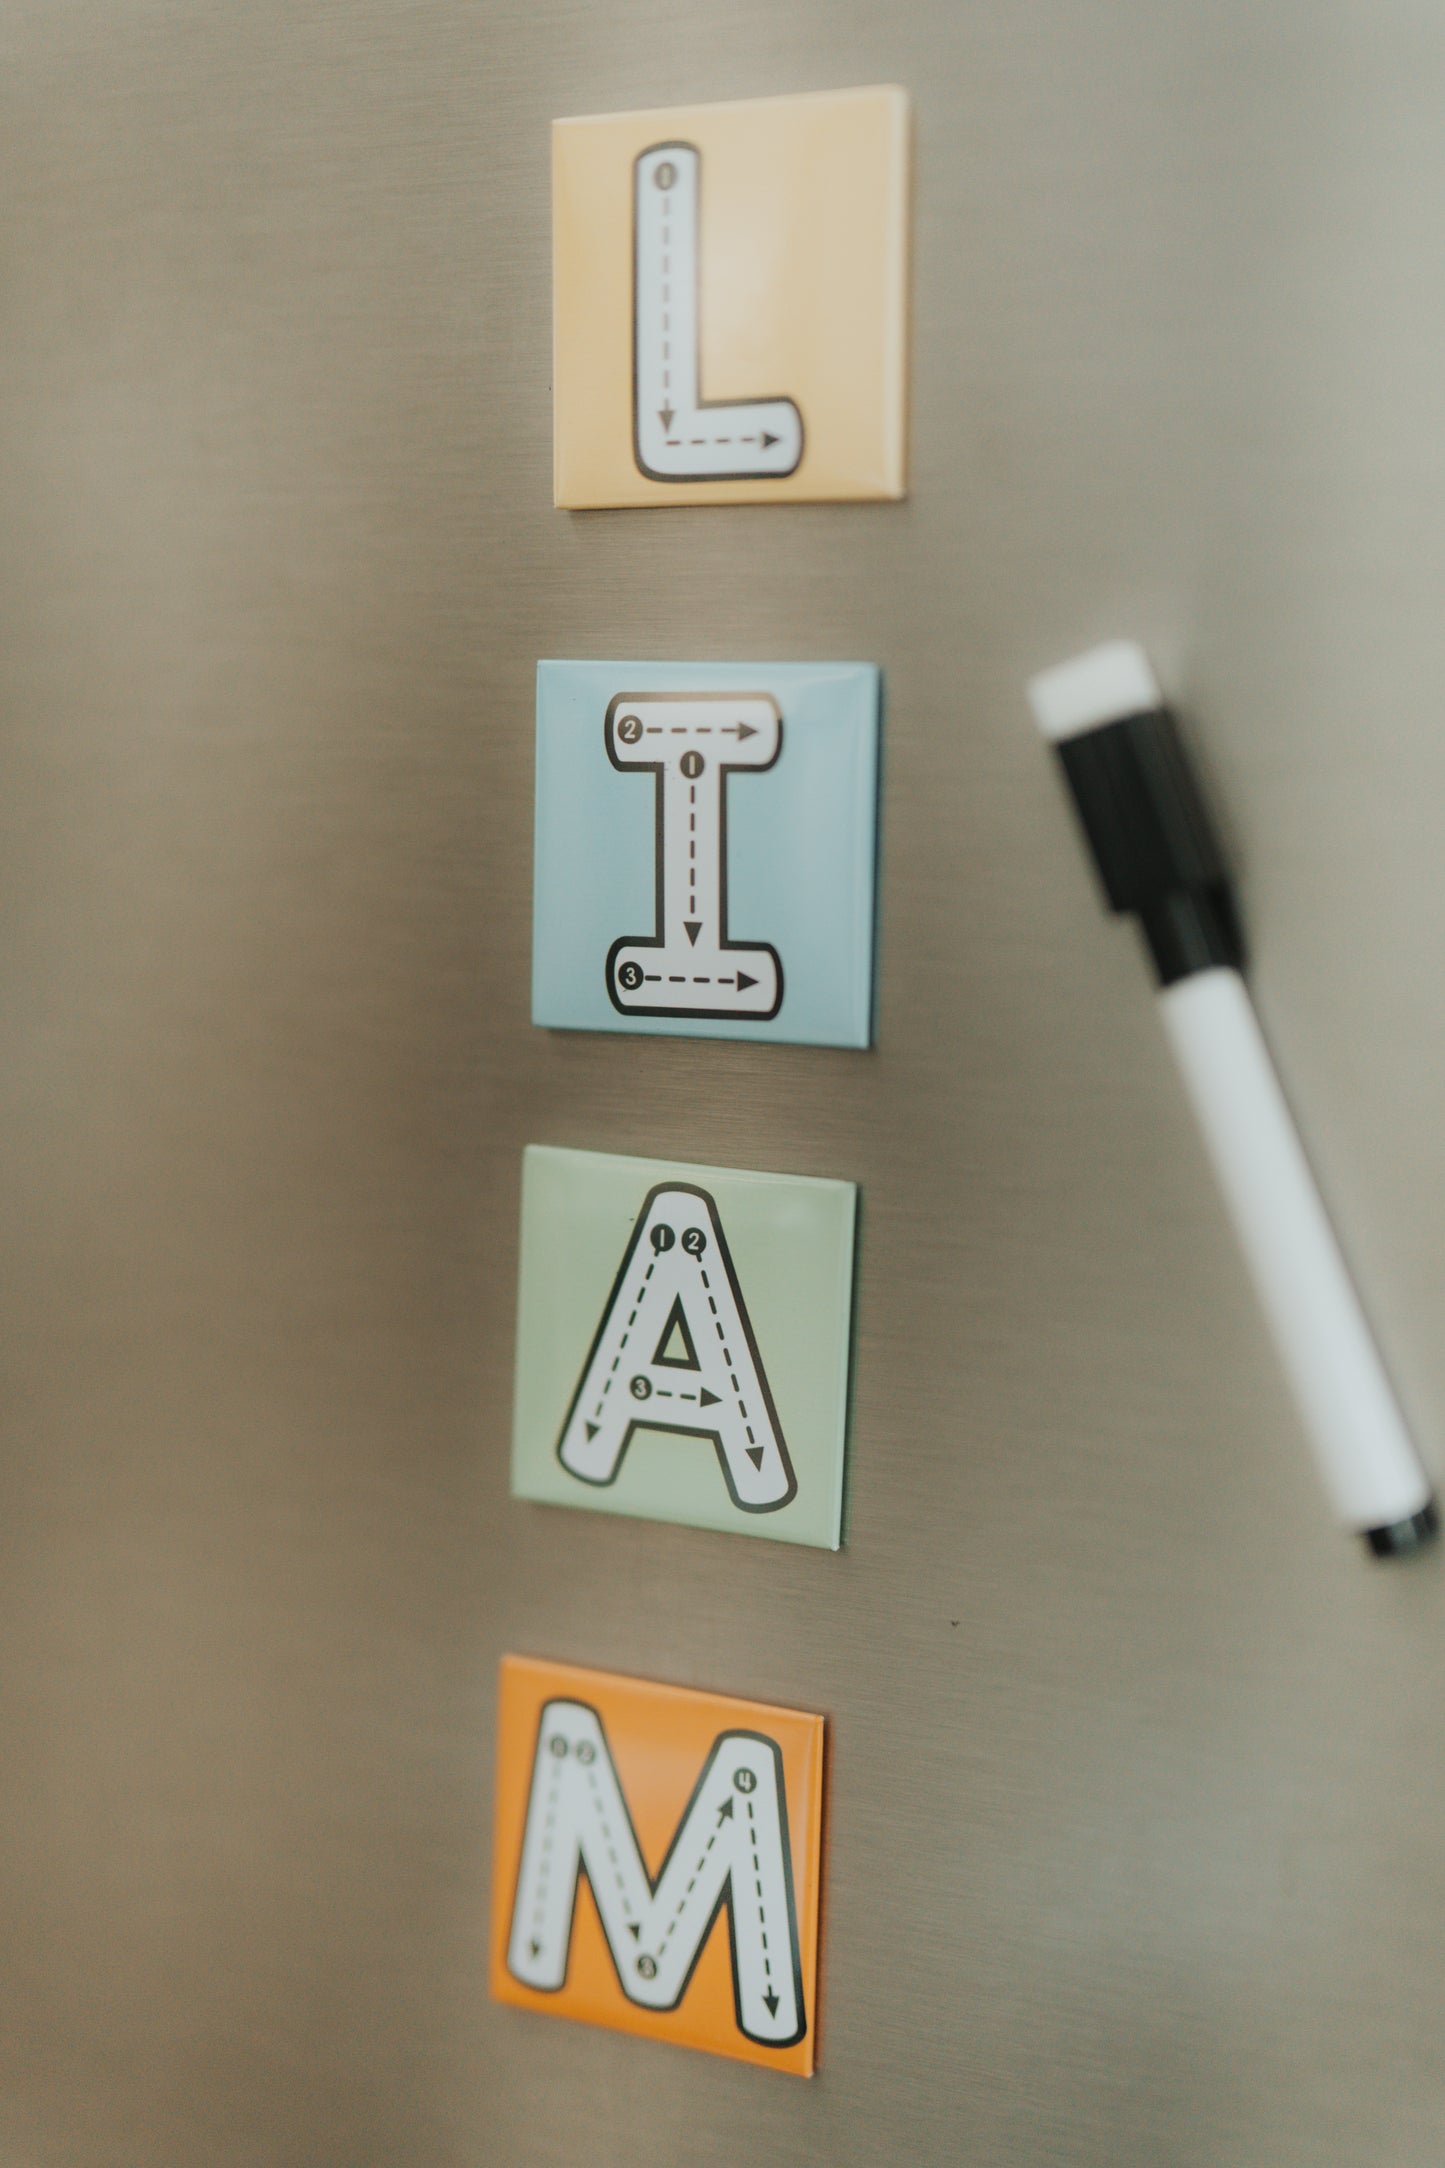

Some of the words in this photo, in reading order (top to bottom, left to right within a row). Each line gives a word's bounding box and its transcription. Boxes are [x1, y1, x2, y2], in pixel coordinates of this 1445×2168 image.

[632, 140, 805, 484] L
[604, 691, 784, 1021] I
[556, 1180, 799, 1515] A
[506, 1696, 807, 2049] M
